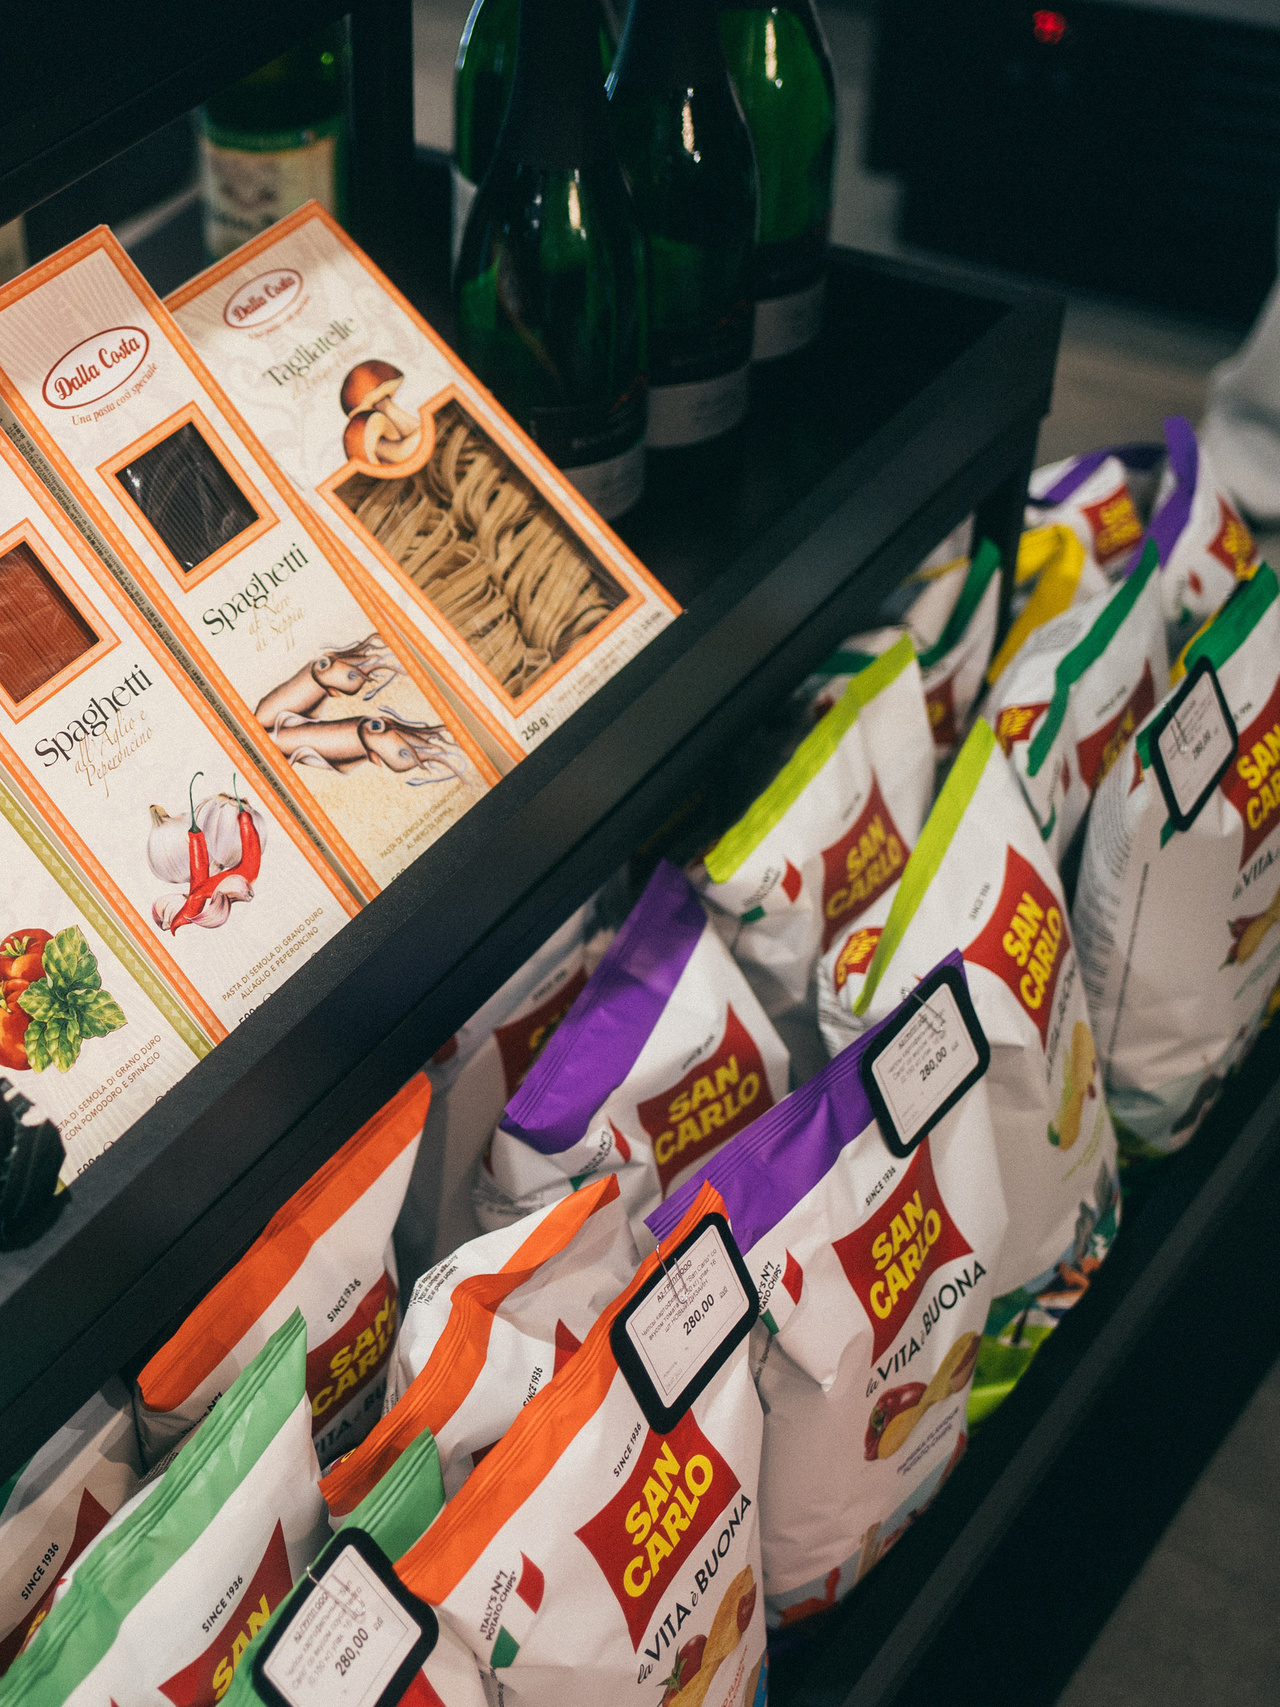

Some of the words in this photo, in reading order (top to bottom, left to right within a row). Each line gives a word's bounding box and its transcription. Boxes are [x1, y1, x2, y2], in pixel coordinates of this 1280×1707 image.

[54, 363, 101, 401] Dalla
[98, 336, 141, 369] Costa
[261, 315, 356, 387] Tagliatelle
[71, 414, 92, 426] Una
[93, 402, 116, 422] pasta
[116, 388, 132, 407] così
[131, 362, 158, 395] speciale
[202, 542, 309, 636] Spaghetti
[34, 664, 153, 768] Spaghetti
[100, 708, 135, 756] Aglio
[140, 710, 146, 721] e
[521, 720, 541, 741] 250
[540, 716, 550, 729] g
[83, 726, 153, 798] Peperoncino
[1236, 723, 1280, 790] SAN
[380, 843, 397, 858] PASTA
[826, 833, 903, 920] CARLO
[846, 814, 887, 882] SAN
[221, 982, 243, 1001] PASTA
[241, 974, 251, 985] DI
[249, 952, 276, 977] SEMOLA
[274, 944, 284, 954] DI
[282, 923, 306, 947] GRANO
[304, 906, 324, 927] DURO
[239, 969, 272, 1000] ALL'AGLIO
[270, 964, 278, 972] E
[276, 925, 319, 967] PEPERONCINO
[1002, 891, 1044, 967] SAN
[1019, 906, 1062, 1010] CARLO
[64, 1124, 83, 1141] CON
[81, 1086, 123, 1125] POMODORO
[121, 1081, 129, 1089] E
[127, 1051, 161, 1083] SPINACIO
[69, 1110, 80, 1120] DI
[78, 1084, 108, 1112] SEMOLA
[106, 1076, 117, 1087] DI
[115, 1053, 141, 1078] GRANO
[140, 1034, 162, 1055] DURO
[669, 1054, 741, 1124] SAN
[919, 1046, 948, 1082] 280,00
[654, 1072, 760, 1165] CARLO
[864, 1180, 884, 1207] SINCE
[882, 1166, 896, 1183] 1936
[869, 1208, 941, 1320] CARLO
[871, 1189, 924, 1271] SAN
[327, 1296, 348, 1323] SINCE
[344, 1278, 362, 1298] 1936
[683, 1293, 715, 1336] 280,00
[876, 1337, 921, 1382] VITA
[922, 1260, 987, 1336] BUONA
[329, 1296, 397, 1379] SAN
[531, 1366, 543, 1386] 1936
[613, 1446, 632, 1478] SINCE
[629, 1422, 642, 1445] 1936
[623, 1454, 713, 1598] CARLO
[625, 1440, 681, 1546] SAN
[21, 1565, 45, 1601] SINCE
[41, 1542, 60, 1568] 1936
[694, 1494, 752, 1595] BUONA
[202, 1598, 228, 1634] SINCE
[225, 1575, 244, 1602] 1936
[479, 1595, 498, 1633] ITALY'S
[485, 1602, 503, 1641] POTATO
[643, 1602, 692, 1662] VITA
[212, 1594, 271, 1701] SAN
[334, 1627, 369, 1677] 280,00
[637, 1662, 654, 1685] la
